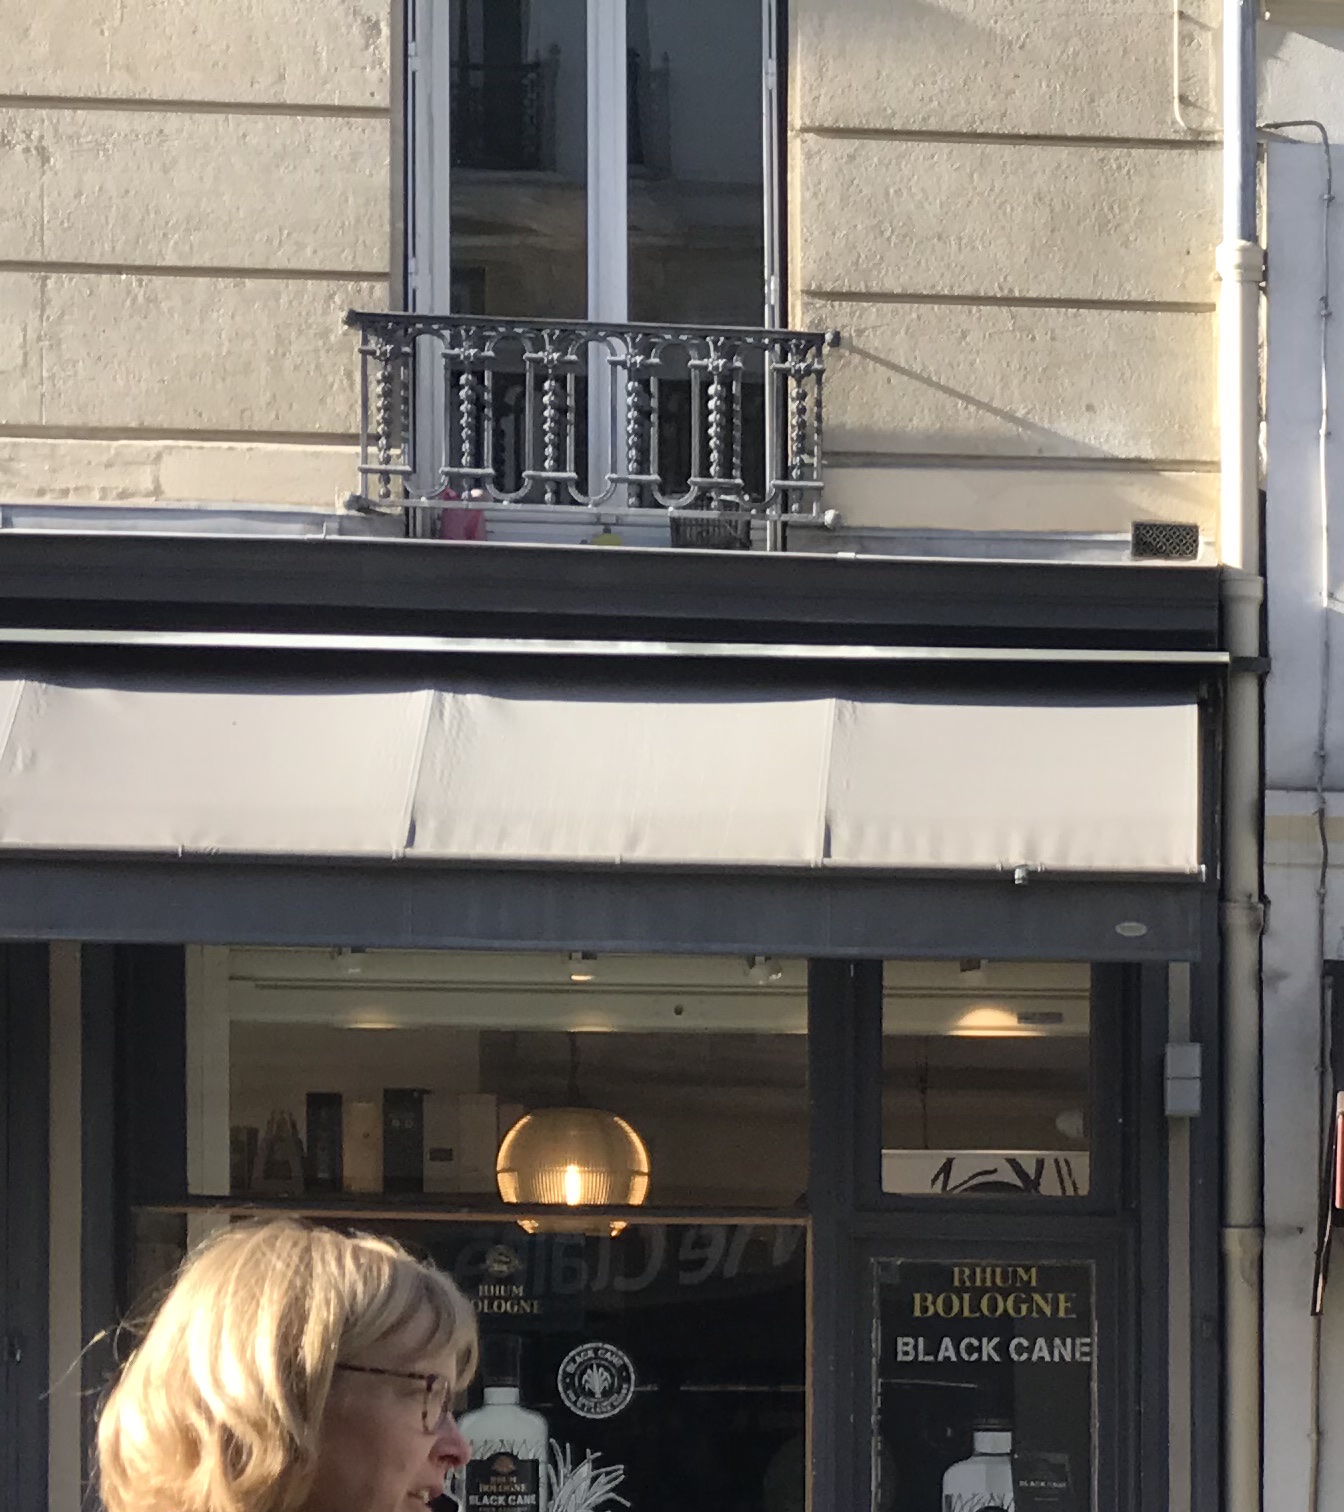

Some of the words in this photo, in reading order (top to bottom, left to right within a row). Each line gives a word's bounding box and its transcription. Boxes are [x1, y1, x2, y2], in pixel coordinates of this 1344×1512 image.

[952, 1266, 1038, 1288] RHUM
[473, 1299, 542, 1315] OLOGNE
[912, 1292, 1077, 1318] BOLOGNE
[896, 1336, 1001, 1362] BLACK
[1008, 1336, 1092, 1362] CANE
[468, 1494, 506, 1506] BLACK
[508, 1494, 537, 1506] CANE
